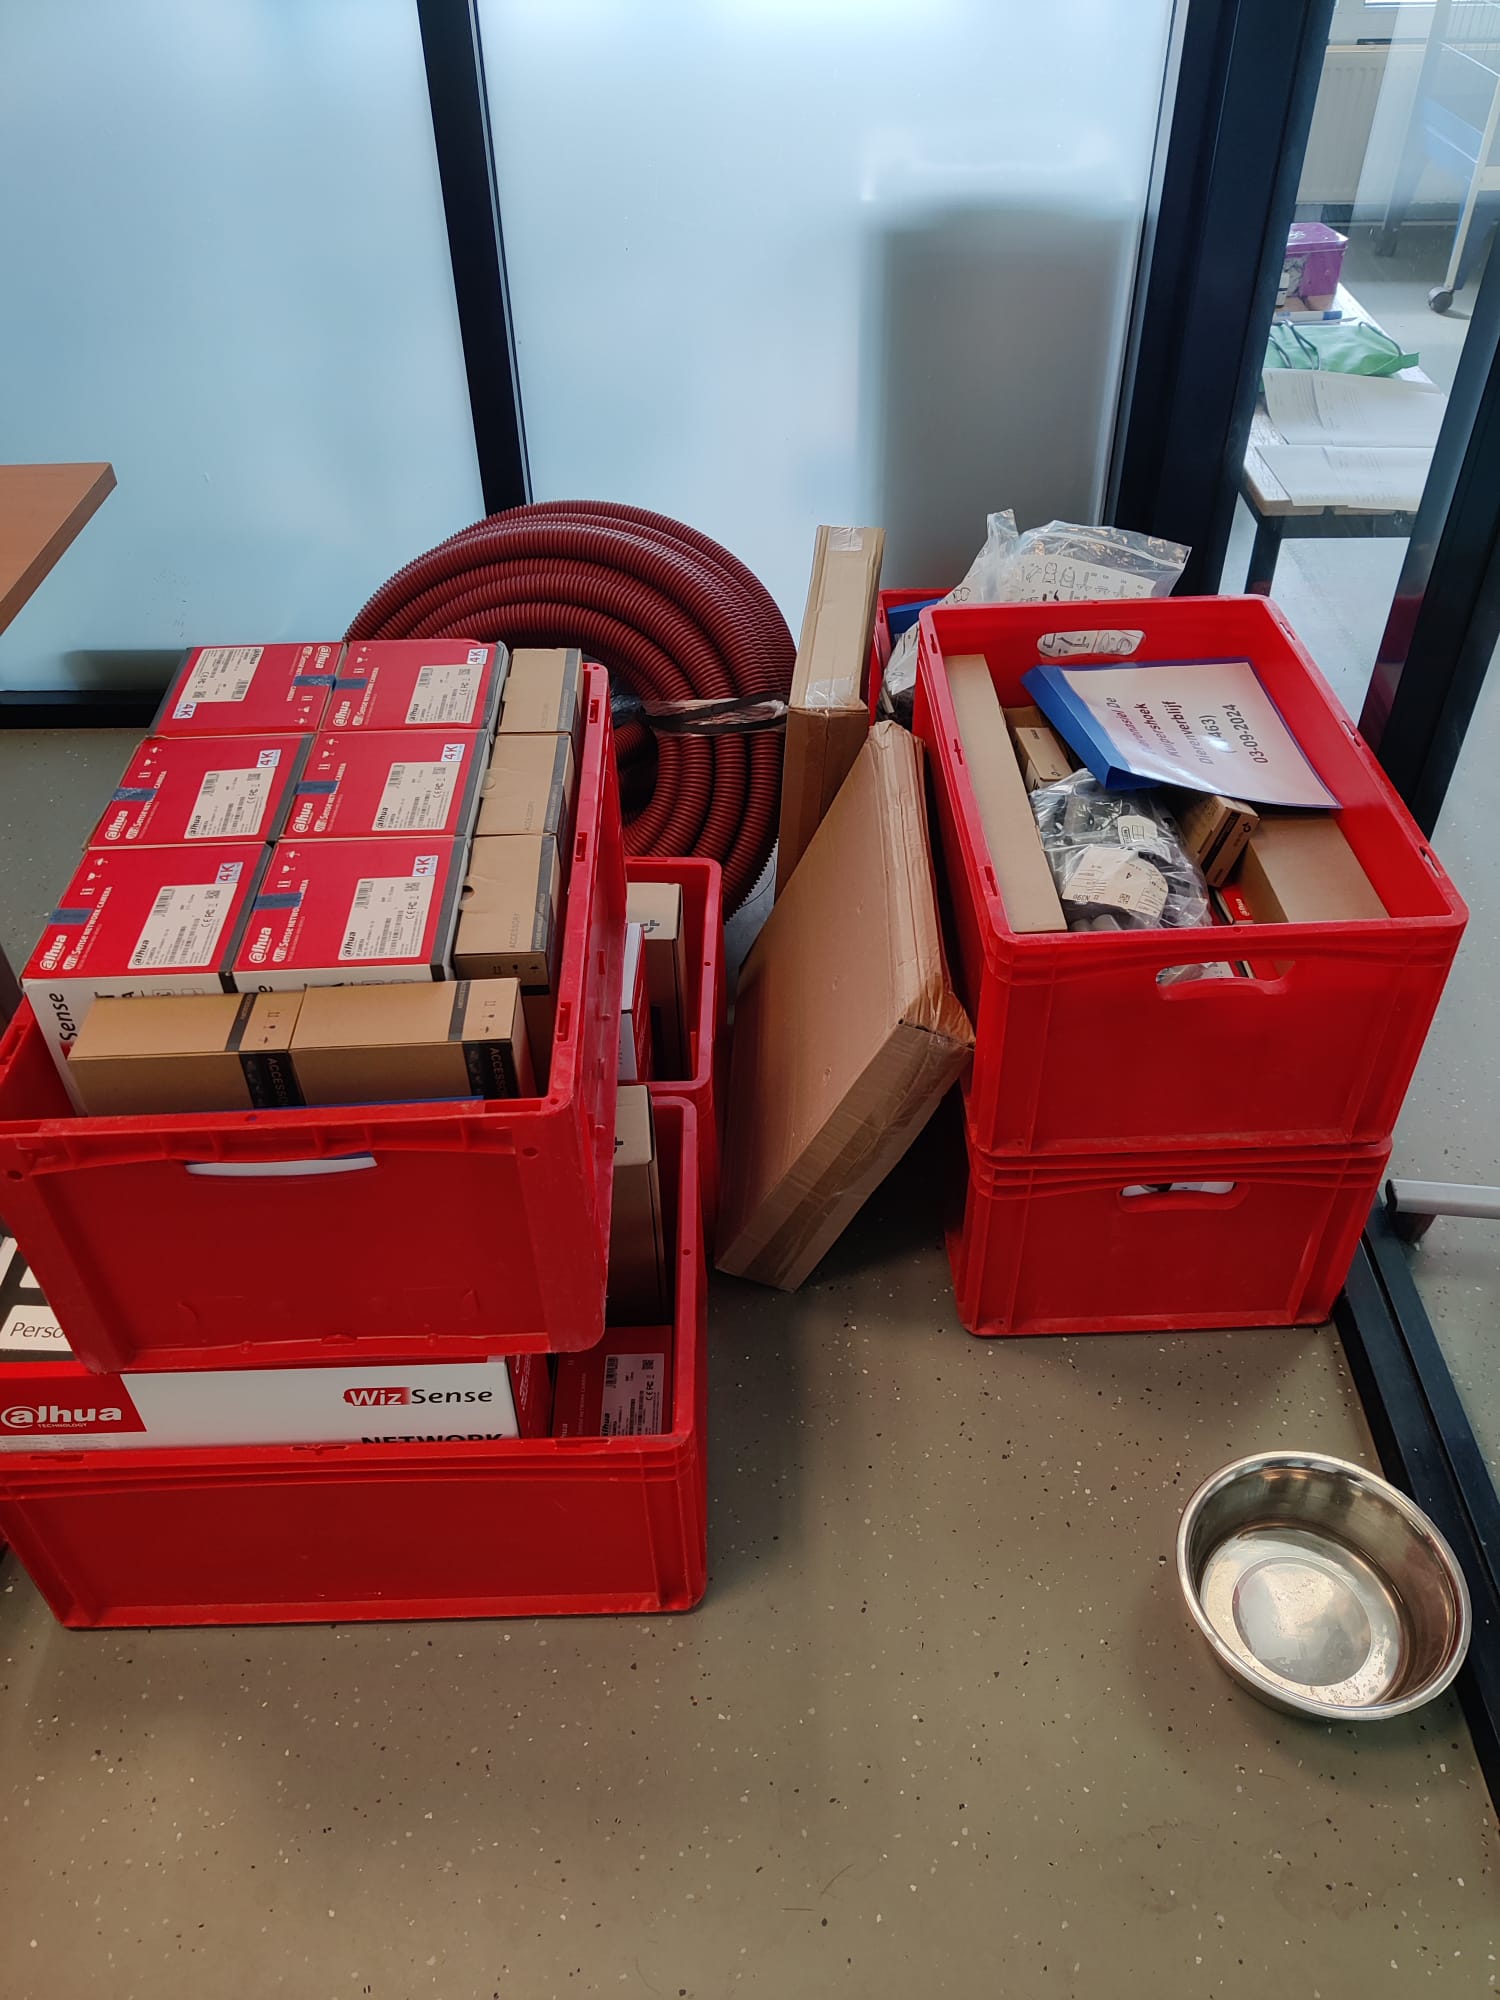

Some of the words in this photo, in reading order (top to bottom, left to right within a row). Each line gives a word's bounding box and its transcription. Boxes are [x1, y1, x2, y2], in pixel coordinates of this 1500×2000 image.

[469, 651, 482, 663] 4K
[180, 704, 194, 717] 4K
[1105, 697, 1121, 709] De
[1134, 703, 1182, 758] Kuipershoek
[1162, 700, 1215, 765] Dierenverblijf
[1198, 714, 1238, 753] (463)
[1222, 704, 1269, 764] 03-09-2024
[260, 752, 274, 765] 4K
[446, 745, 459, 759] 4K
[219, 863, 236, 881] 4K
[415, 857, 431, 874] 4K
[49, 993, 78, 1041] Sense
[9, 1322, 66, 1339] Perso
[350, 1390, 402, 1406] Wiz
[411, 1389, 493, 1404] Sense
